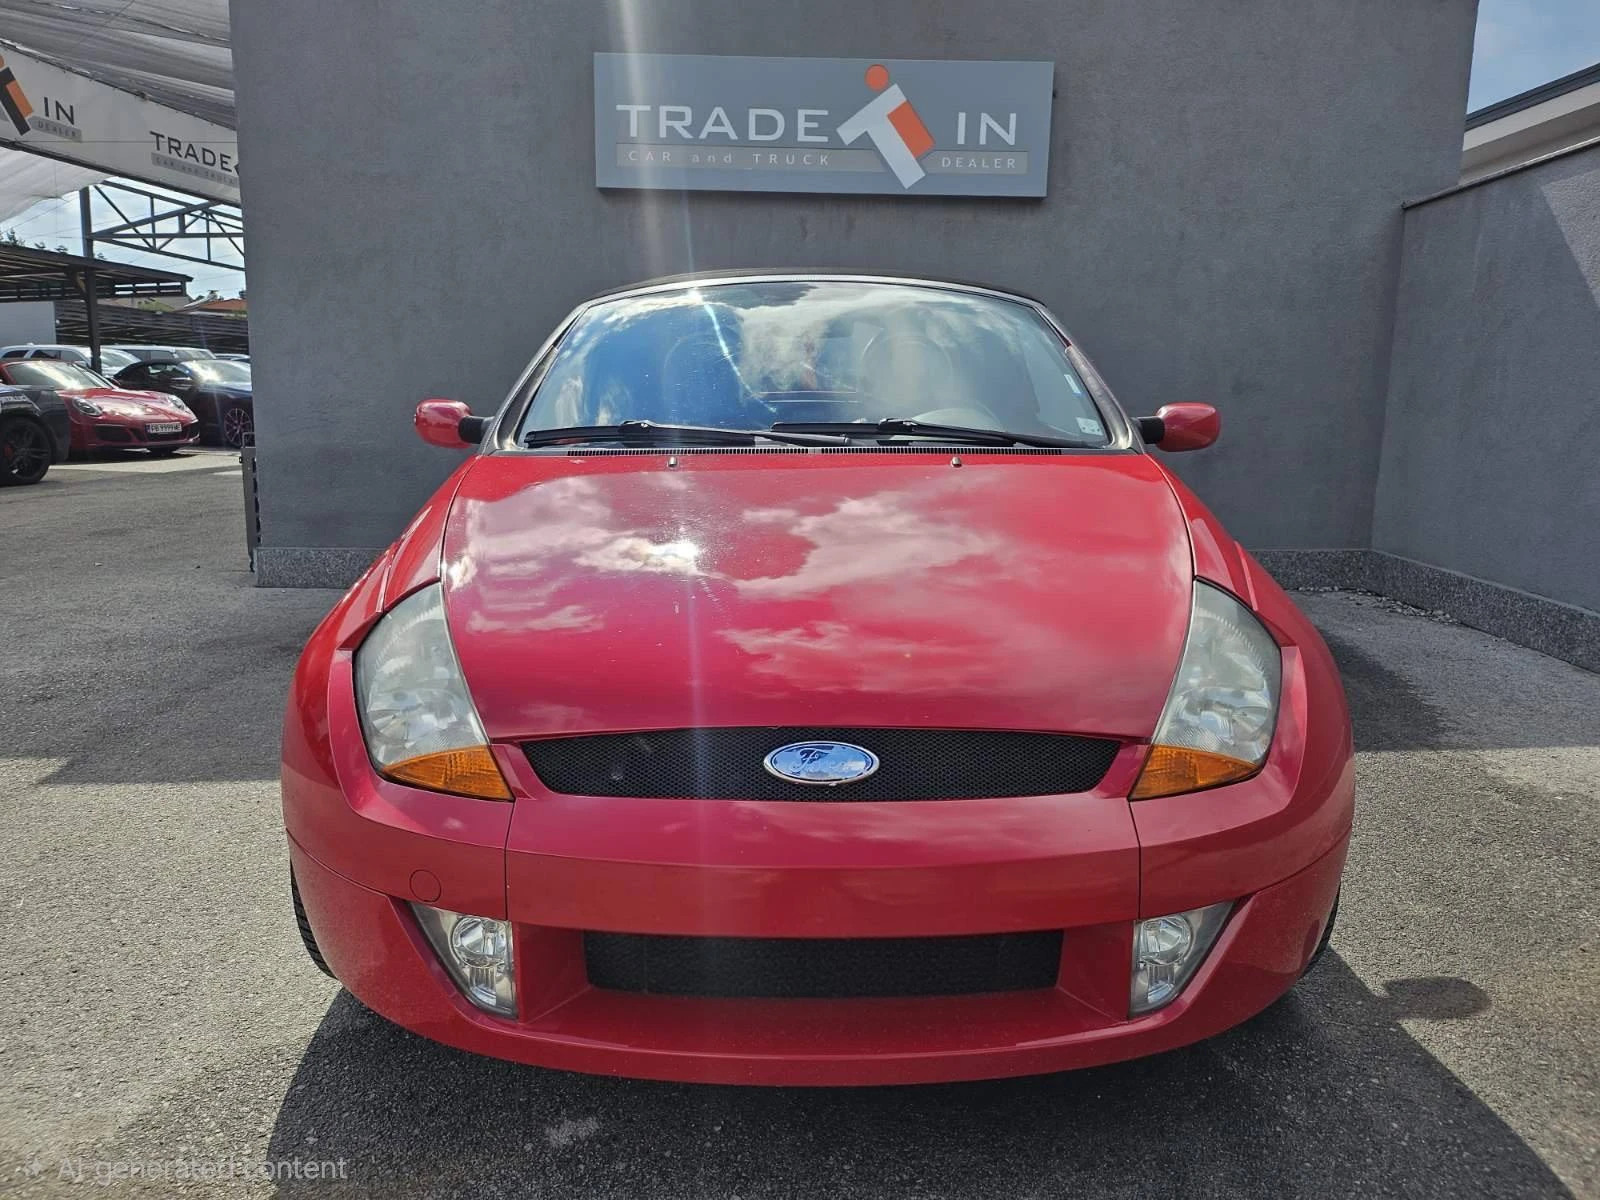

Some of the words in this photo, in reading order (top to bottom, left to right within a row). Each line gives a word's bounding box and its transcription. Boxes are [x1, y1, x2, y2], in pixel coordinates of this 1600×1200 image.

[43, 96, 76, 126] IN
[615, 104, 829, 142] TRADE
[957, 111, 1017, 146] IN
[149, 130, 233, 173] TRADE
[627, 150, 672, 162] CAR
[691, 152, 733, 164] and
[752, 153, 829, 166] TRUCK
[941, 156, 1016, 169] DEALER
